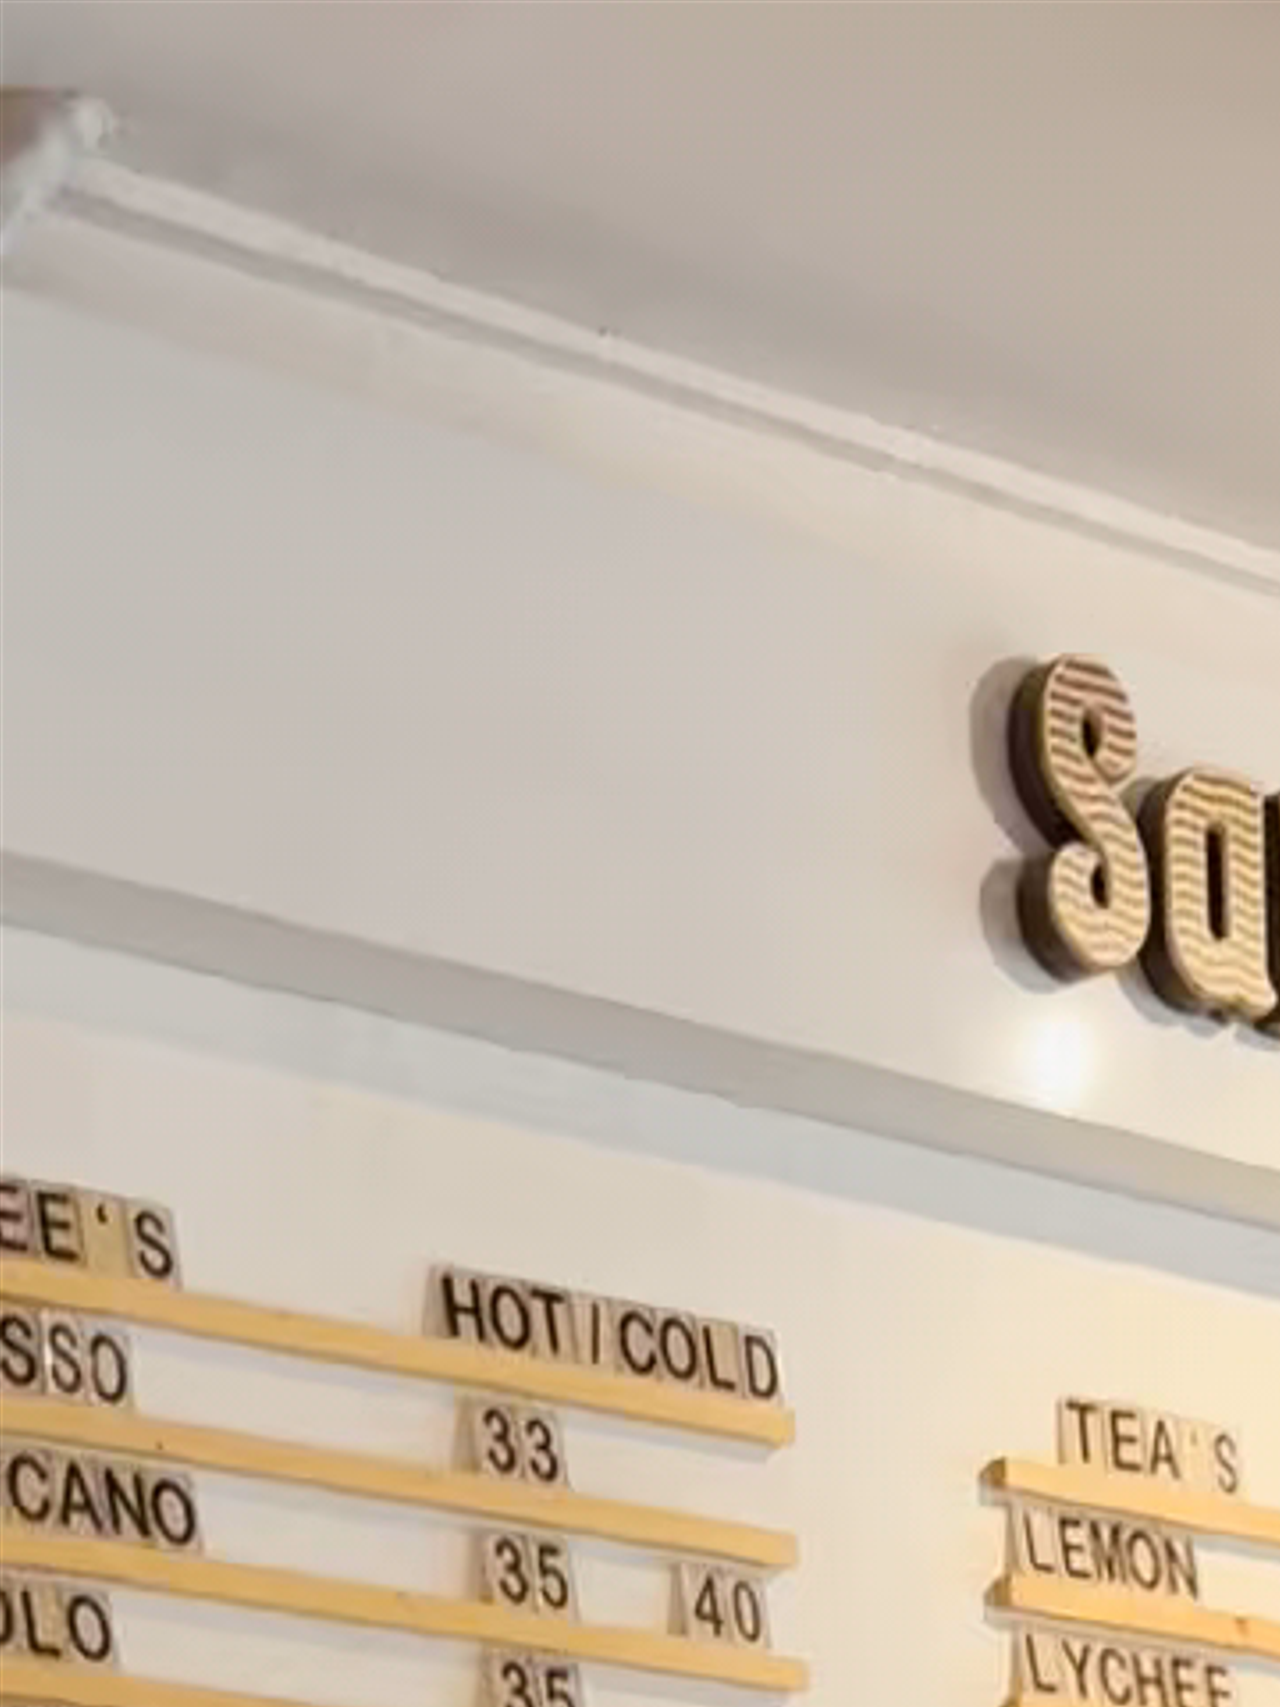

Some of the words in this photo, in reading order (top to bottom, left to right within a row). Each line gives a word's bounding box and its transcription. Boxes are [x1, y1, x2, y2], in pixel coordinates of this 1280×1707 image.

[483, 1408, 560, 1483] 33
[1066, 1400, 1240, 1494] TEA'S
[8, 1452, 196, 1546] CANO
[495, 1538, 570, 1609] 35
[692, 1575, 764, 1643] 40
[1021, 1513, 1200, 1602] LEMON
